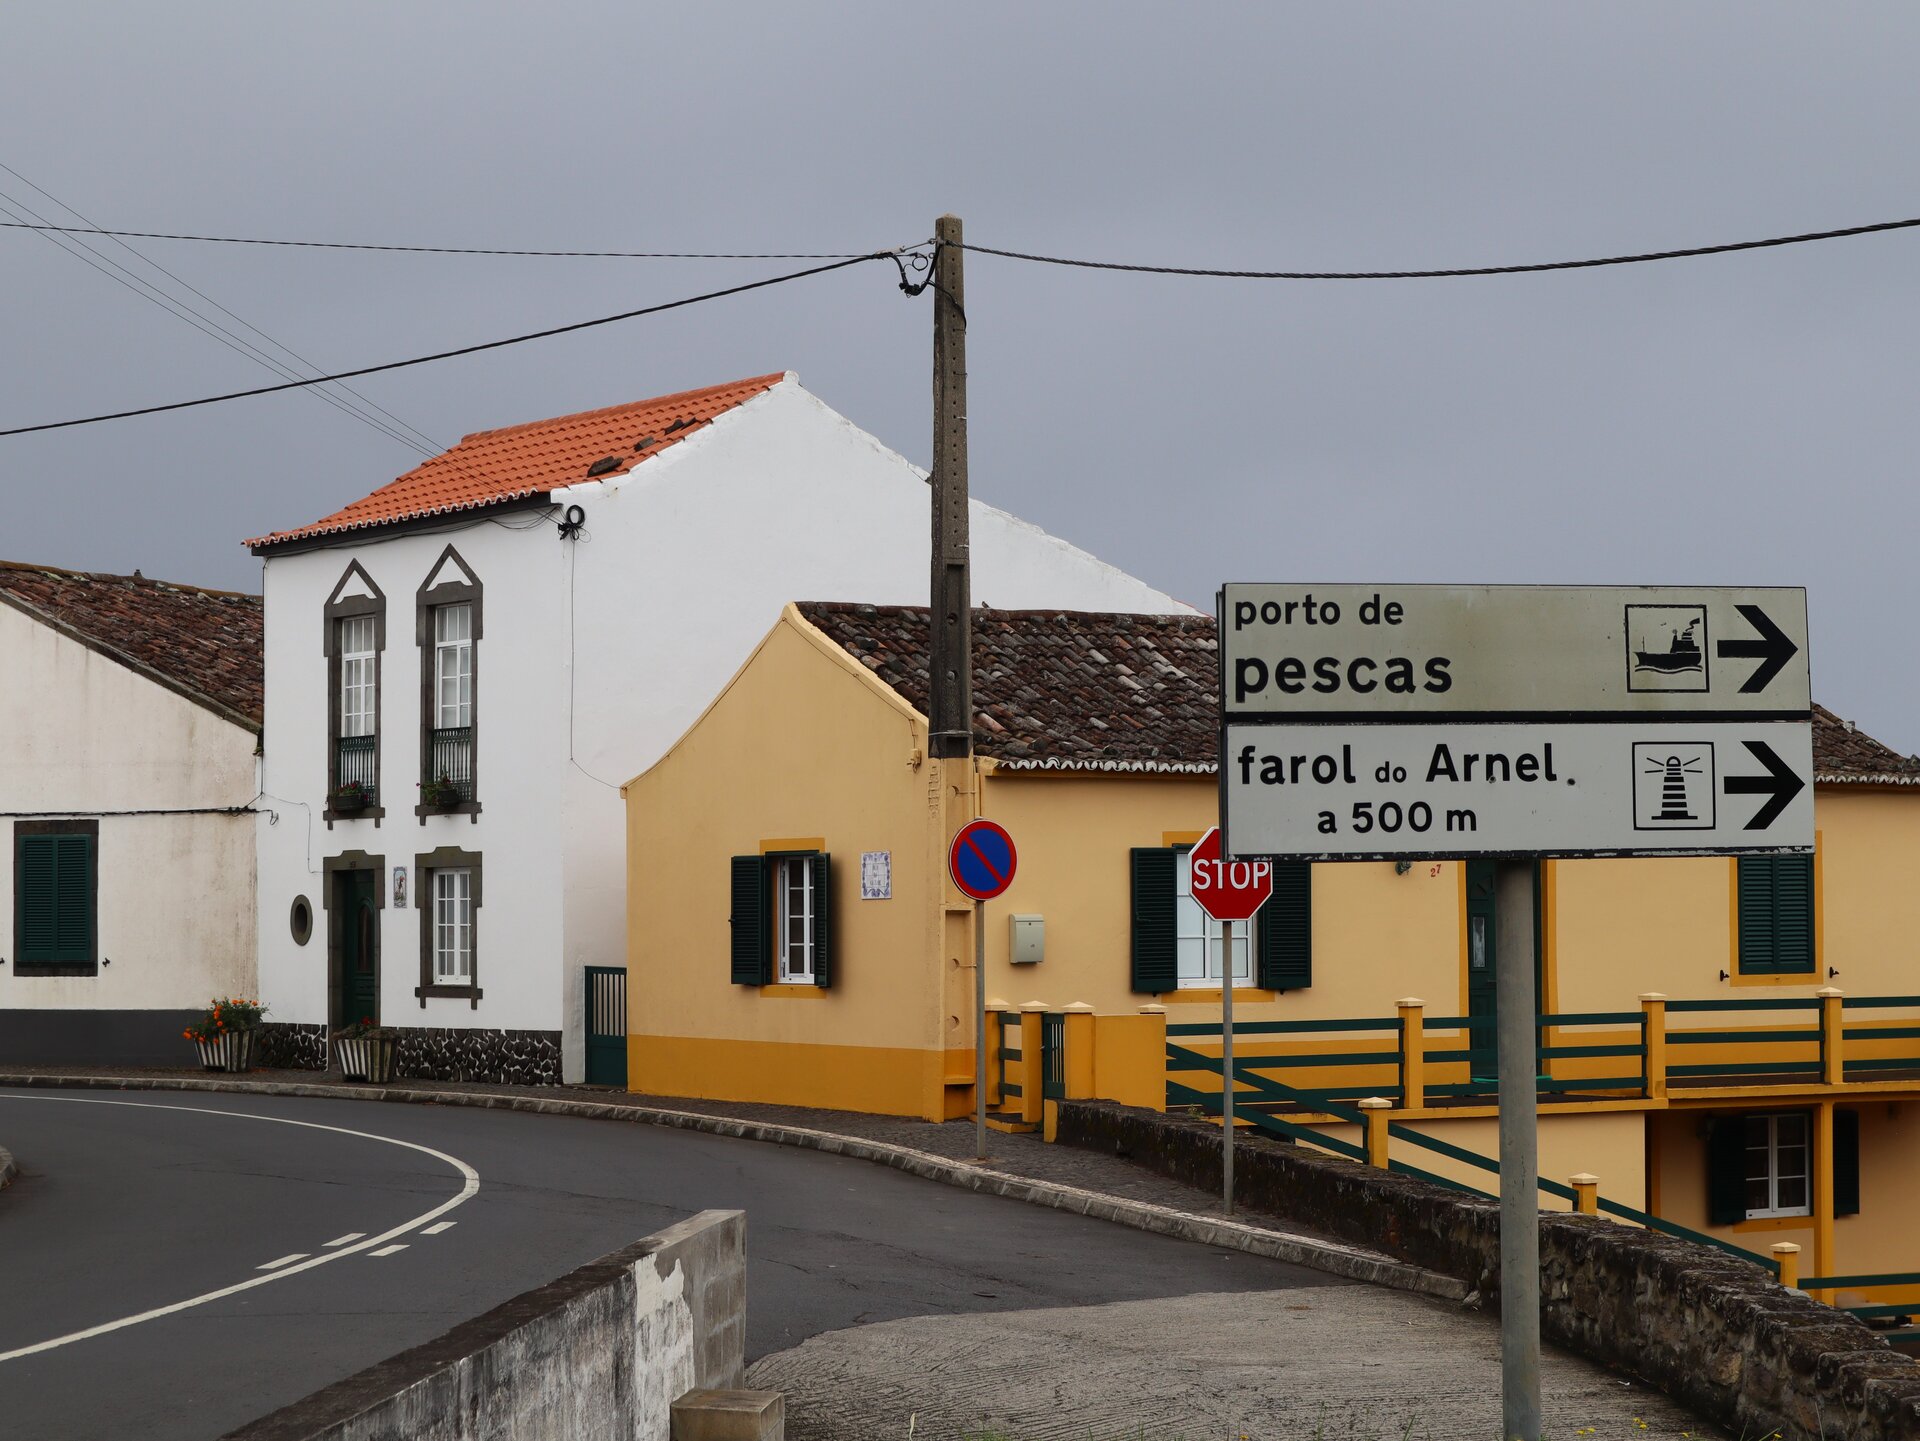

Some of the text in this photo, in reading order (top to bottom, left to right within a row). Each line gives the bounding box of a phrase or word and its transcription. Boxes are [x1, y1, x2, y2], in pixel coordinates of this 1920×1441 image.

[1235, 594, 1404, 631] porto de
[1235, 656, 1453, 704] pescas
[1238, 744, 1357, 785] farol
[1374, 760, 1407, 784] do
[1317, 801, 1477, 834] a 500 m
[1193, 858, 1270, 890] STOP
[1430, 863, 1442, 878] 27
